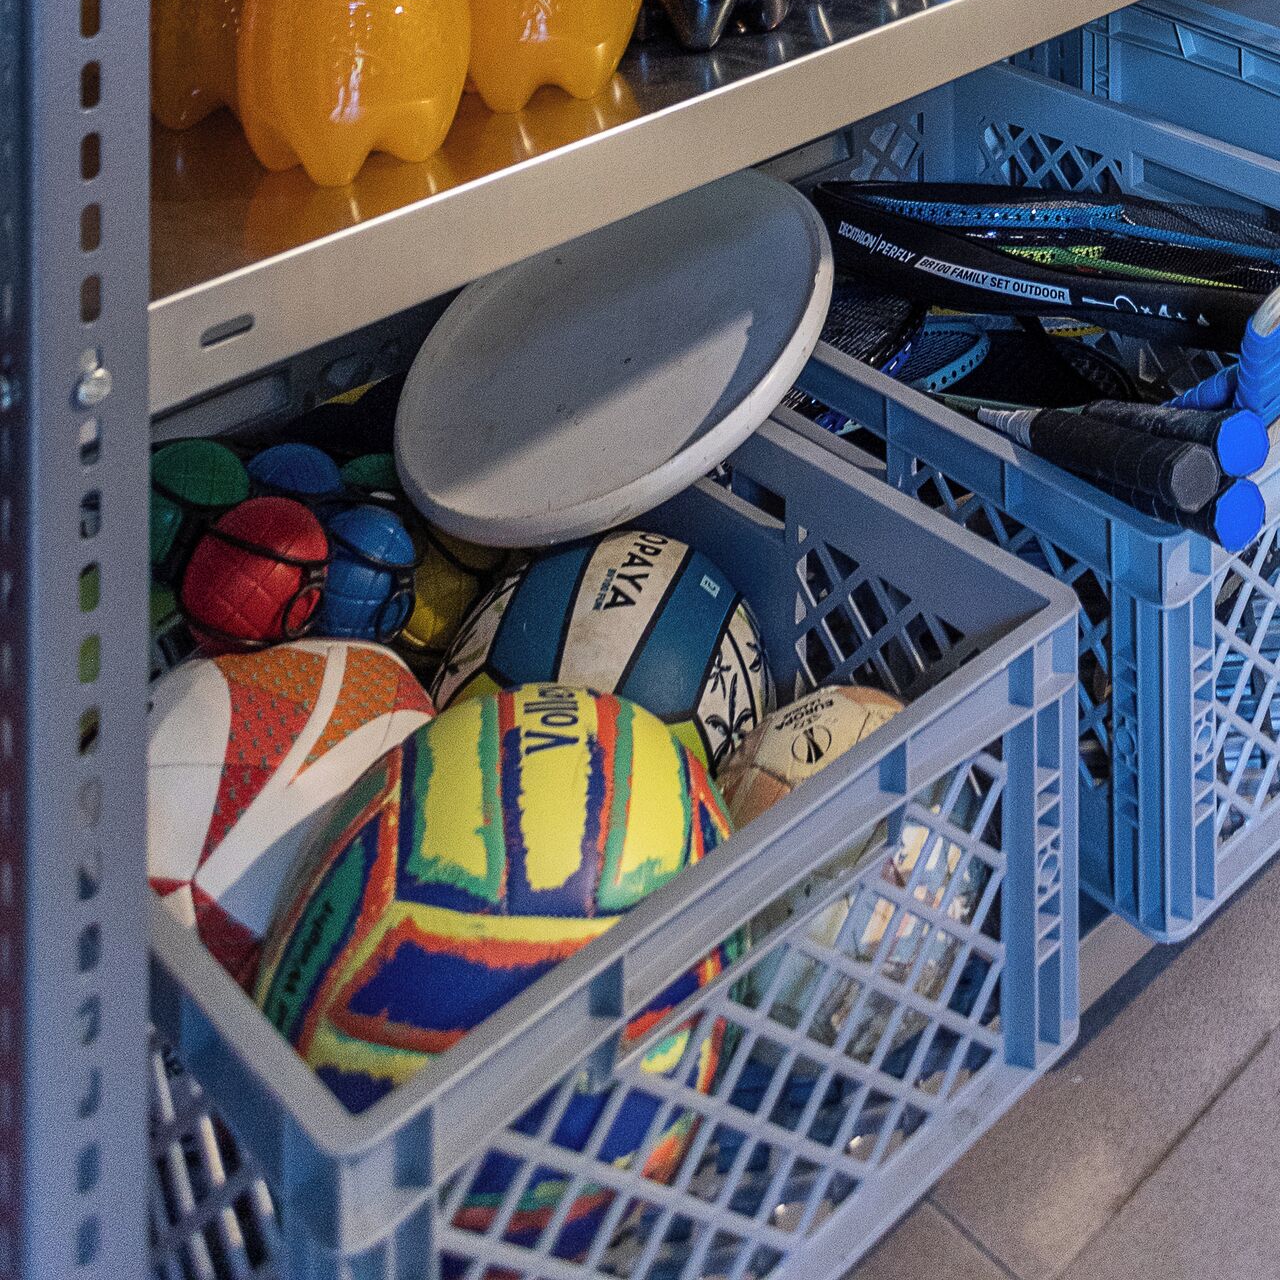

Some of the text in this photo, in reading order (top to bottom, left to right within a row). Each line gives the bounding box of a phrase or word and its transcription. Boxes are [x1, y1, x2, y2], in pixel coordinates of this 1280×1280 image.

[838, 220, 916, 264] DECATHLON PERFLY
[920, 258, 1067, 302] BR100 FAMILY SET OUTDOOR
[602, 534, 669, 611] OPAYA
